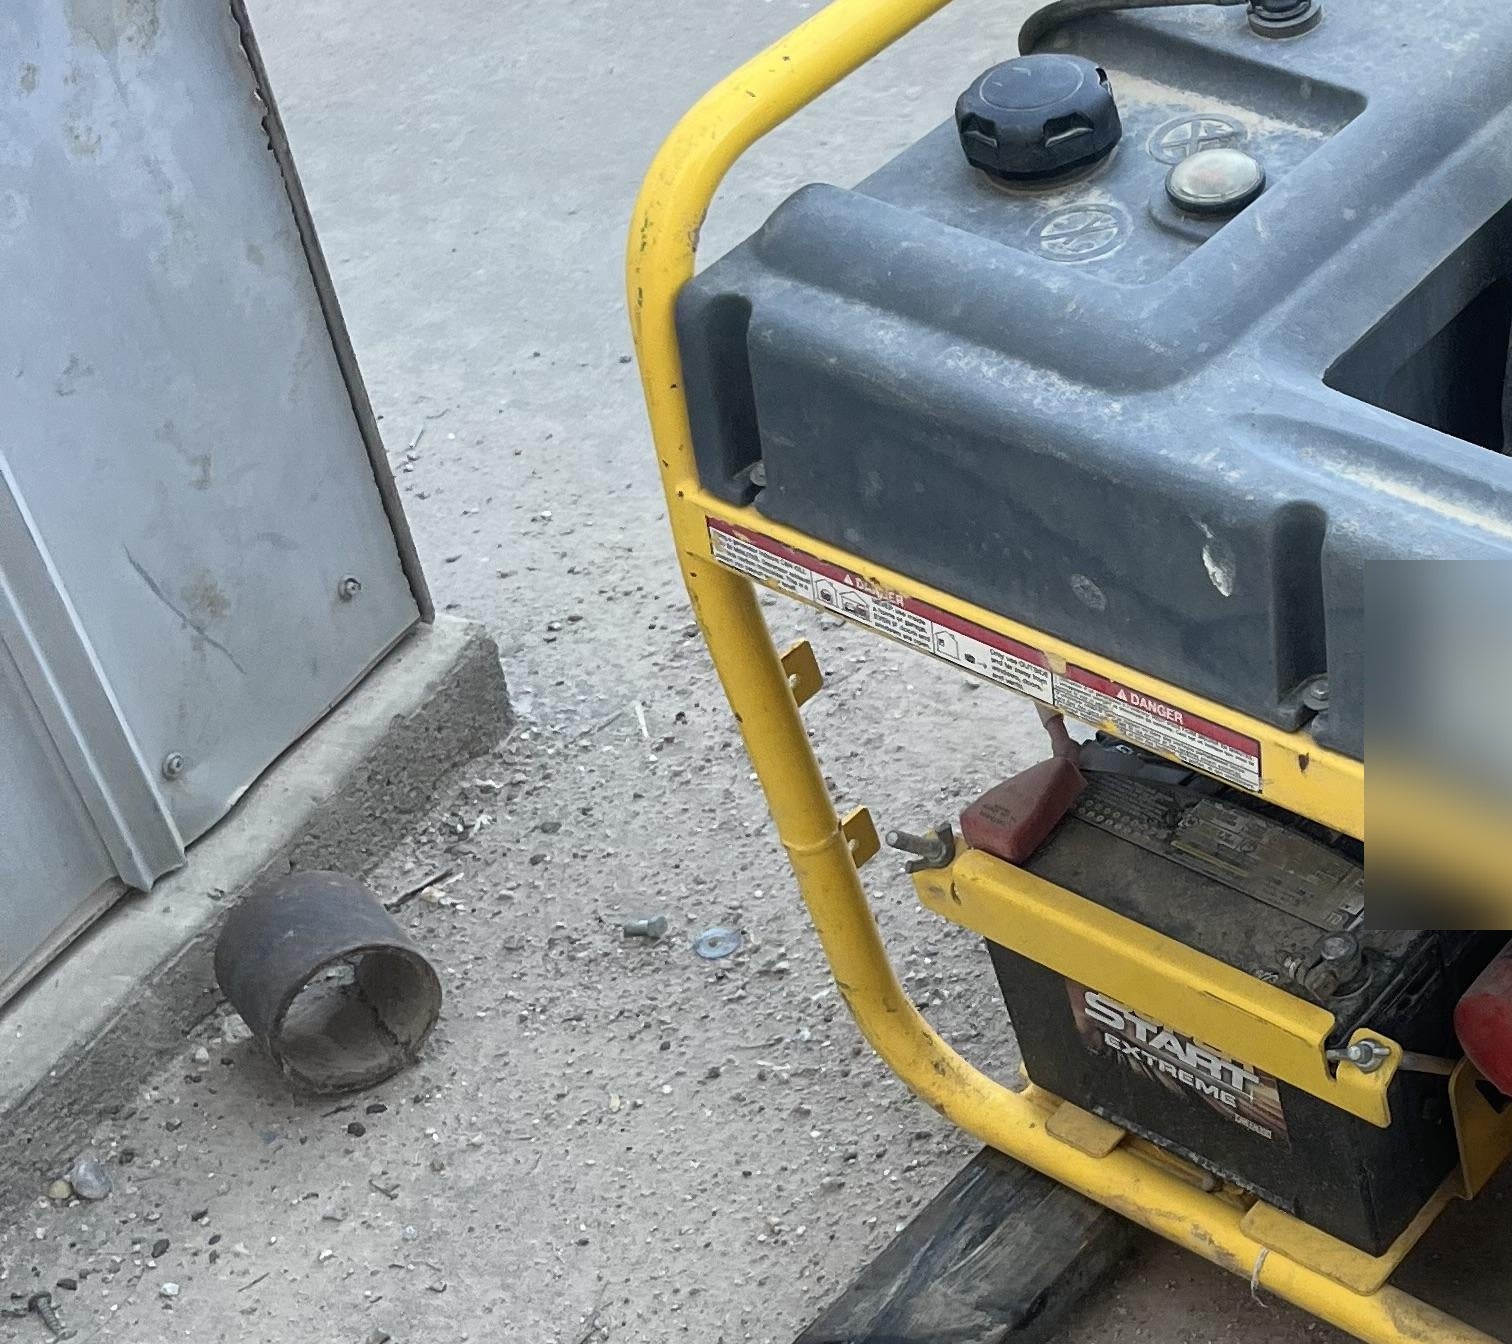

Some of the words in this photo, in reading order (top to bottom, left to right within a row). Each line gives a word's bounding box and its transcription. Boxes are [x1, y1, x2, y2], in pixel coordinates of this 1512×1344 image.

[1130, 693, 1184, 725] DANGER
[1084, 991, 1260, 1091] START
[1104, 1032, 1237, 1108] EXTREME
